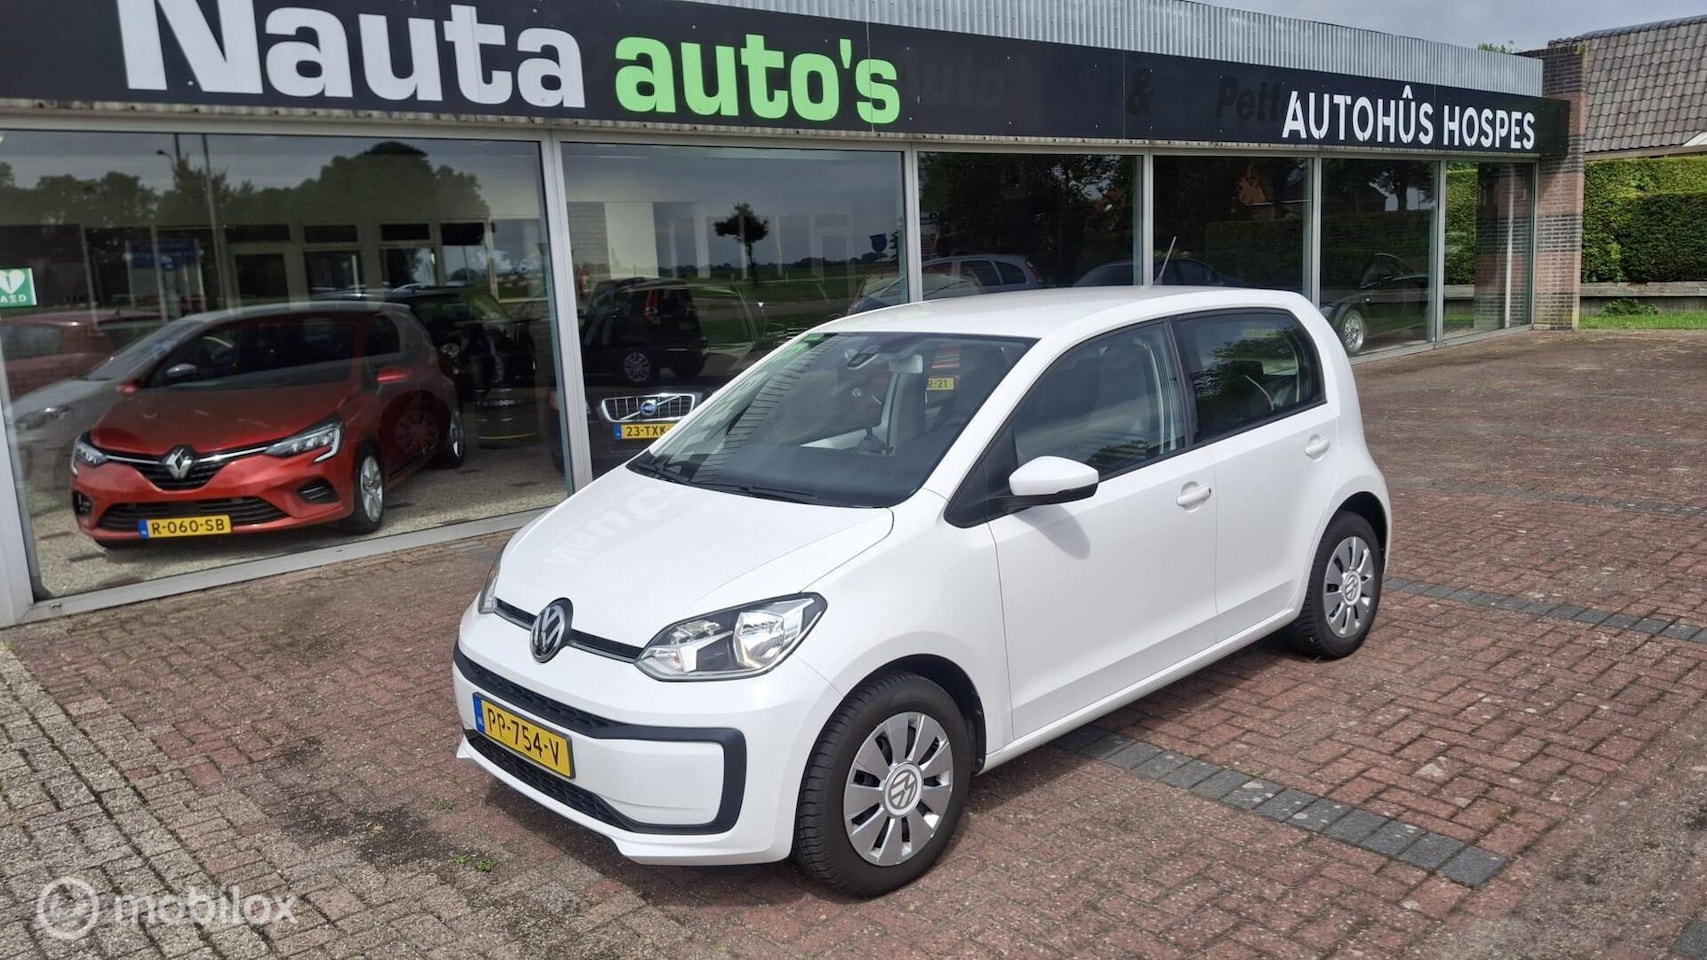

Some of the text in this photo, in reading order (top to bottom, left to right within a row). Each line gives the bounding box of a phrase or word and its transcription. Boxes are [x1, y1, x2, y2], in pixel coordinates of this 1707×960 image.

[118, 0, 899, 124] Nauta auto's
[1281, 85, 1535, 150] AUTOHÛS HOSPES
[626, 426, 670, 437] 23-TXK-
[151, 519, 225, 535] R-060-SB
[487, 707, 559, 766] PP-754-V
